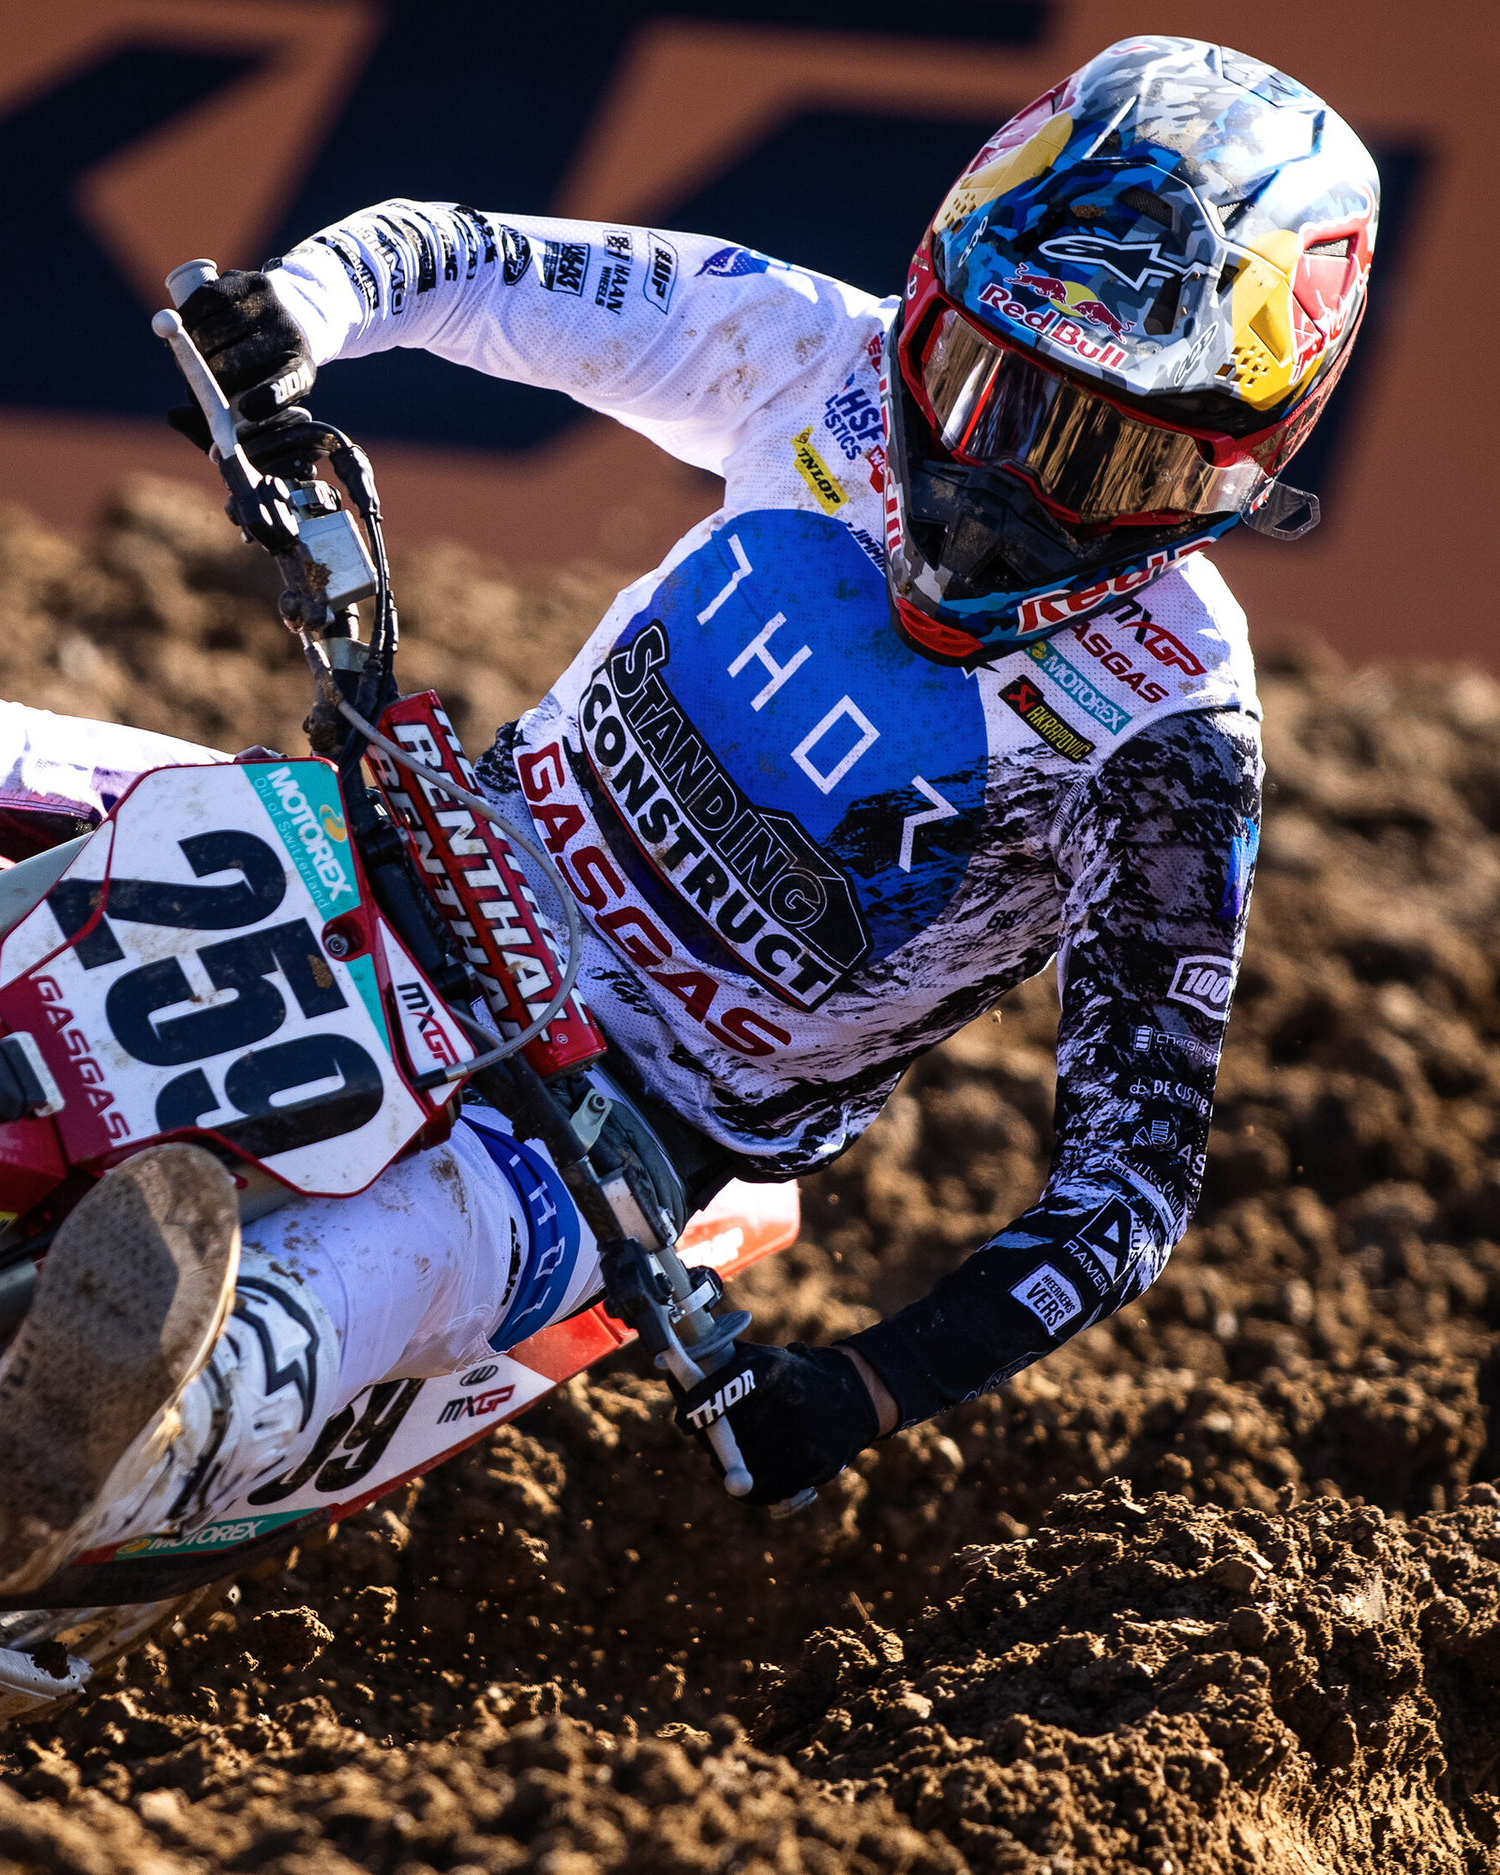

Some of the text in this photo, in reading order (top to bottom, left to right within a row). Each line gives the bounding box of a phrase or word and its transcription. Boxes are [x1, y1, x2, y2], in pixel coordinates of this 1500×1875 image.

[595, 265, 613, 307] WHEELS
[606, 263, 631, 315] HAAN
[977, 282, 1061, 334] Red
[1048, 316, 1130, 372] Bull
[1042, 655, 1126, 731] MOTOREX
[611, 624, 827, 927] STANDING
[254, 776, 331, 911] Oil of Switzerland
[266, 765, 353, 901] MOTOREX
[582, 684, 838, 997] CONSTRUCT
[517, 741, 792, 1058] GASGAS
[47, 828, 386, 1160] 259
[1181, 966, 1233, 1004] 100
[30, 973, 132, 1146] GASGAS
[1153, 1078, 1172, 1096] DE
[1041, 1273, 1076, 1314] HEERKENS
[1062, 1239, 1110, 1297] RAMEN
[1026, 1280, 1066, 1328] VERS
[435, 1384, 516, 1426] MXGP
[686, 1368, 757, 1430] THOR
